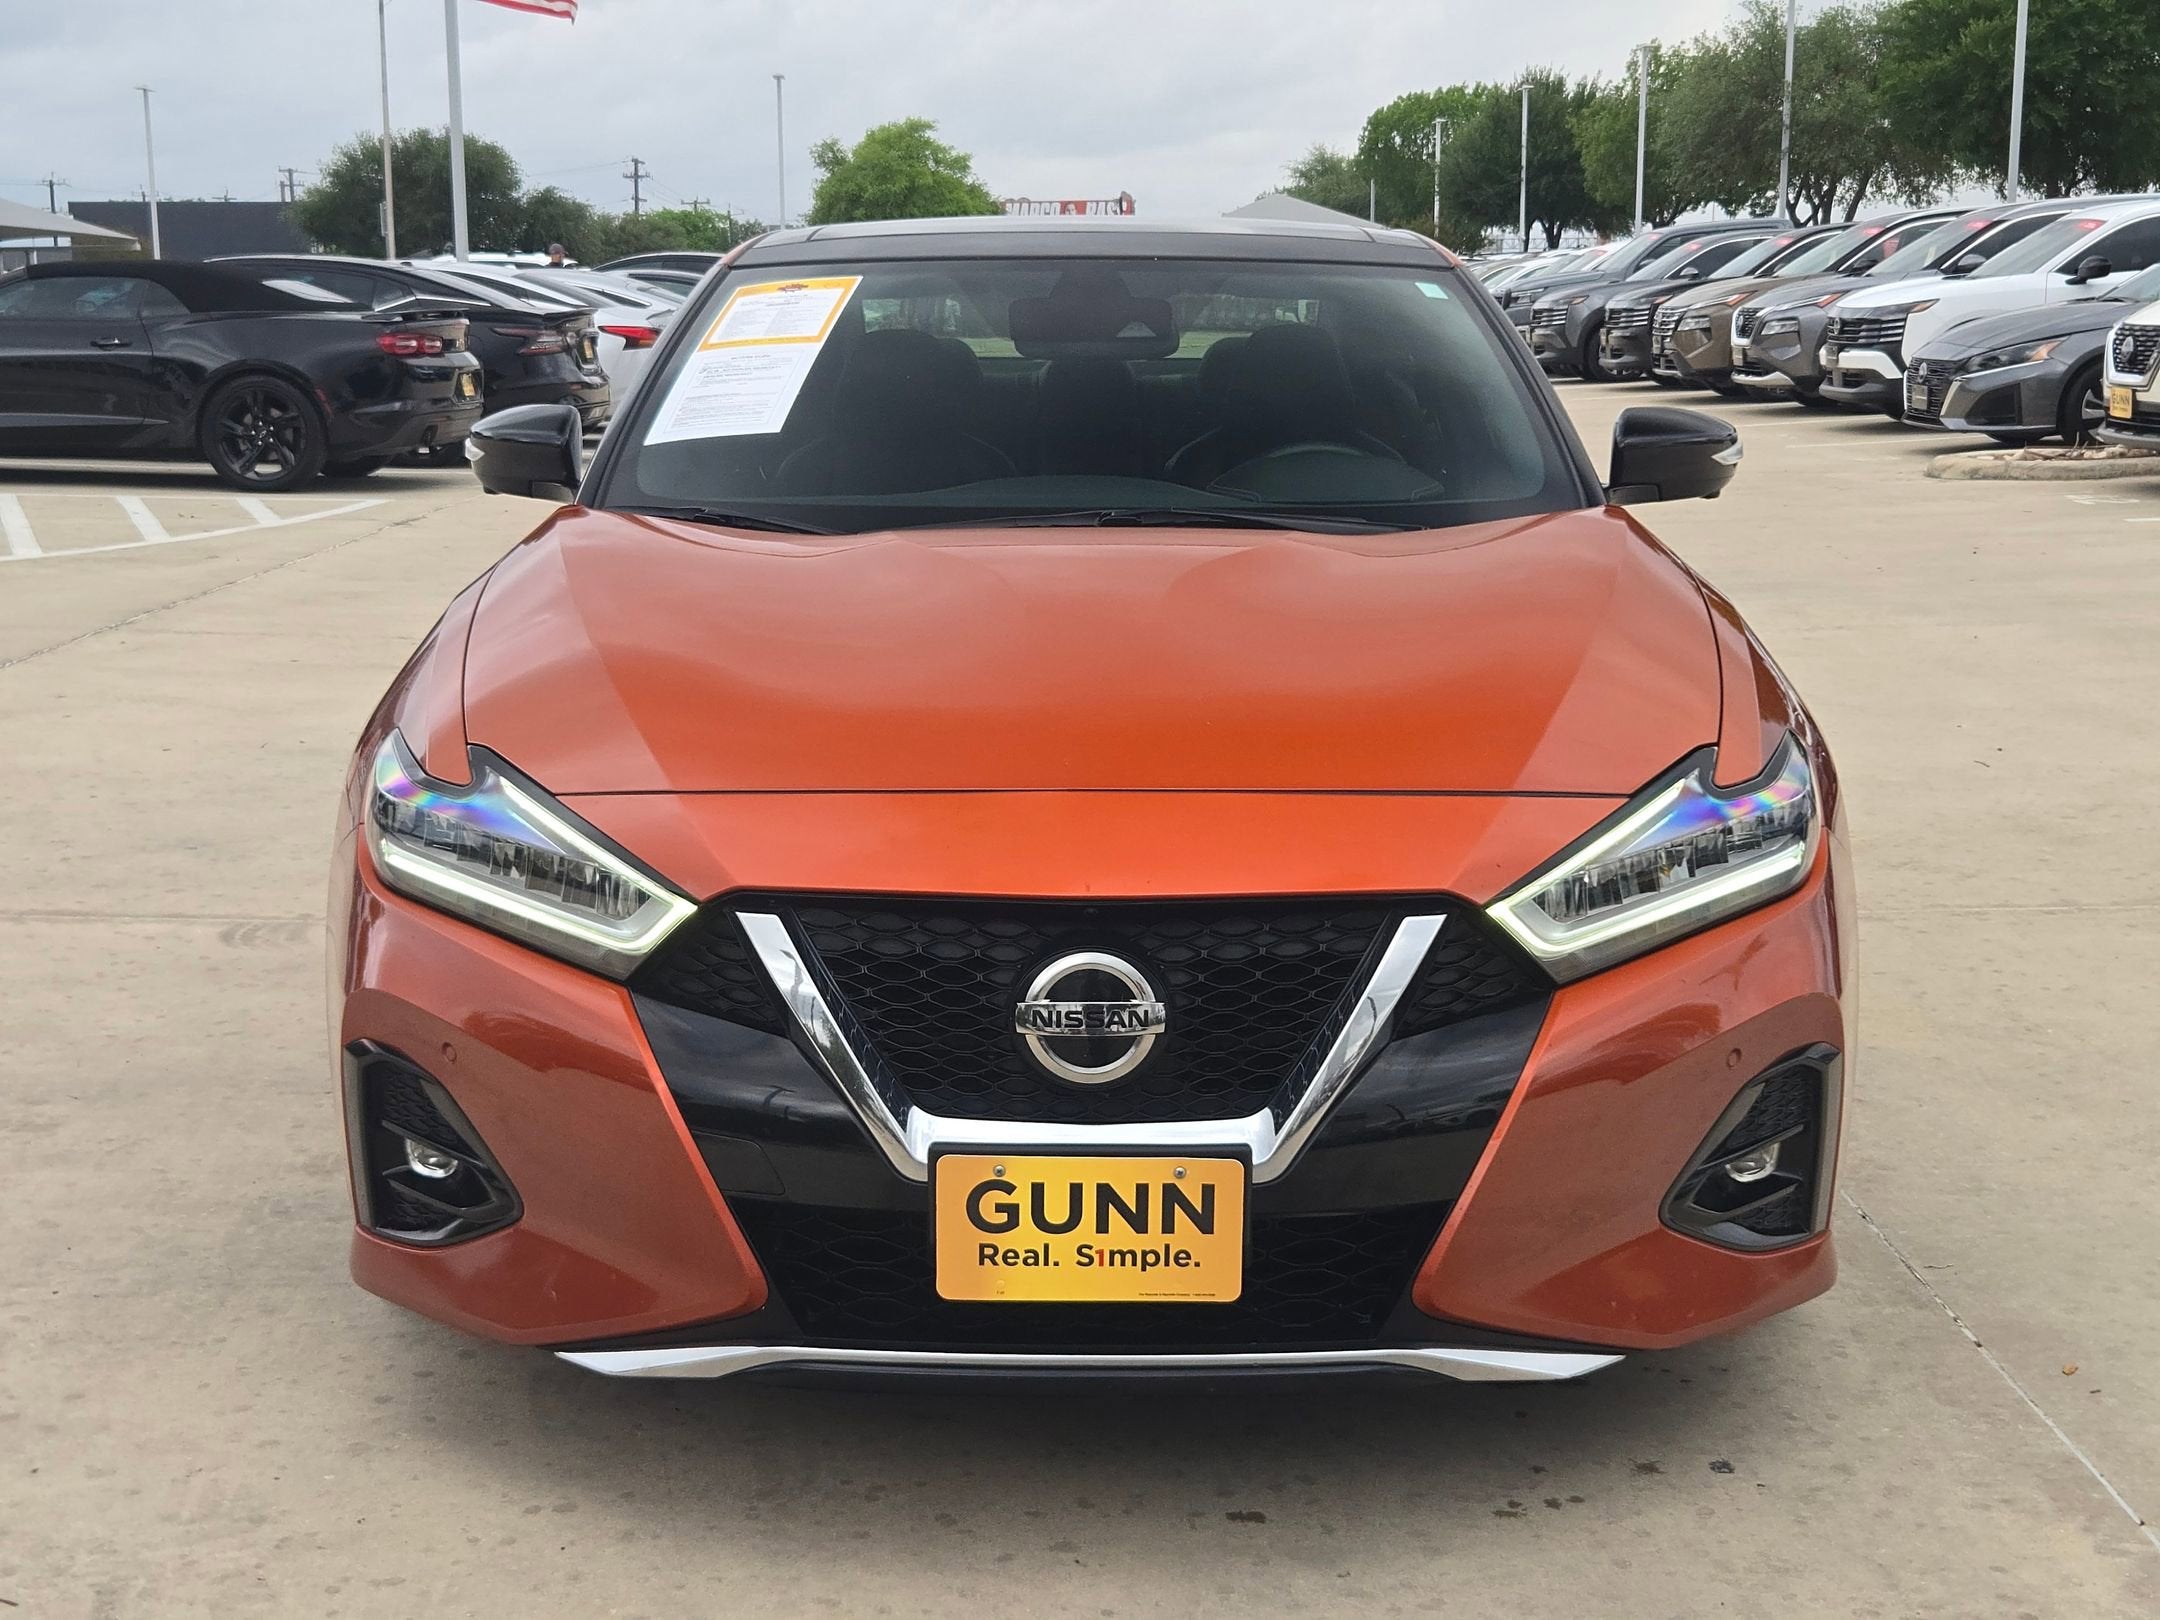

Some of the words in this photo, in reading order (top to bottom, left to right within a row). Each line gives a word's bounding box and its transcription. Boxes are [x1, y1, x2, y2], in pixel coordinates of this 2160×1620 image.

[1032, 1009, 1149, 1028] NISSAN
[965, 1178, 1216, 1236] GUNN
[978, 1242, 1060, 1267] Real.
